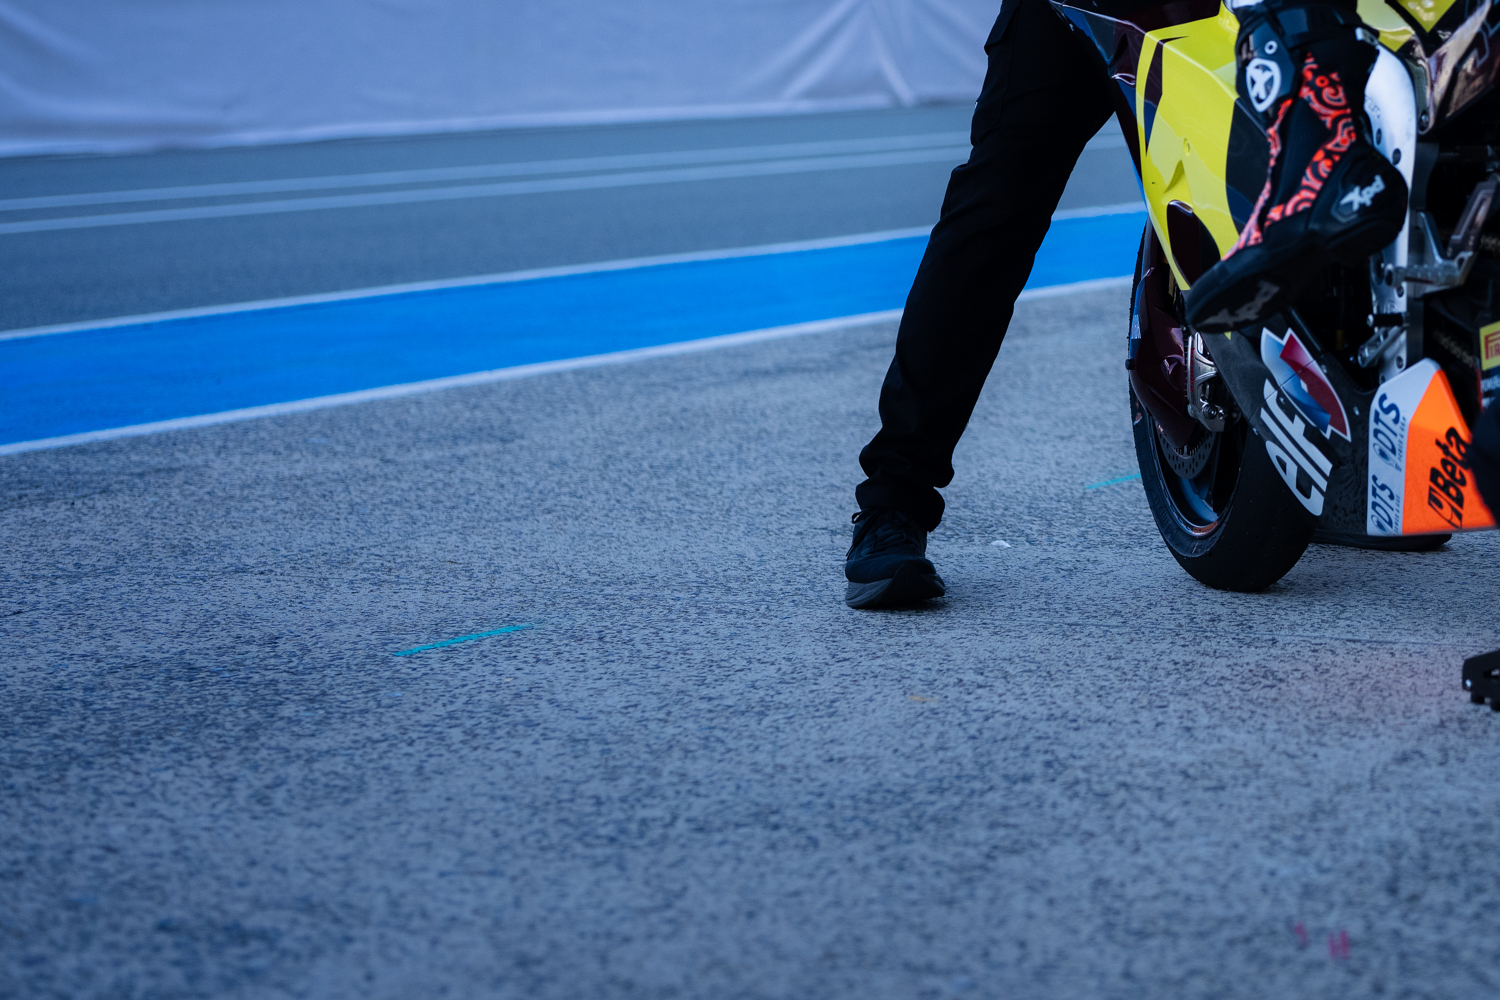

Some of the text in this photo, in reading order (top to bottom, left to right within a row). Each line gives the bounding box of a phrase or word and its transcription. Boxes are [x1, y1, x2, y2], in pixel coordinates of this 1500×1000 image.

[1260, 378, 1334, 517] elf
[1373, 393, 1400, 456] DTS
[1372, 474, 1395, 529] DTS
